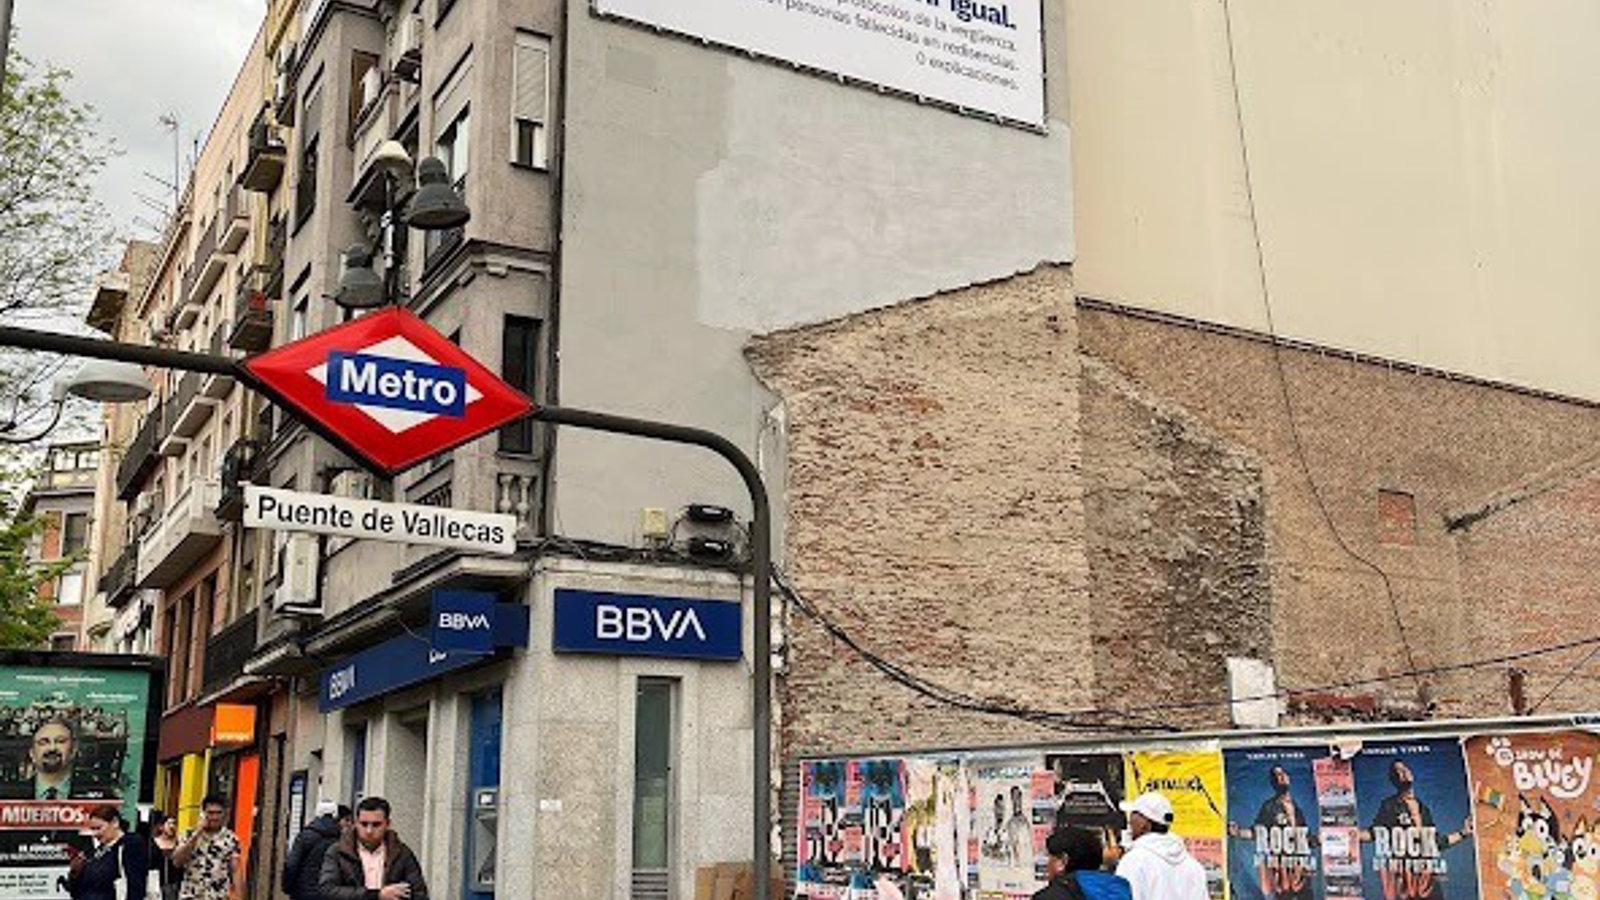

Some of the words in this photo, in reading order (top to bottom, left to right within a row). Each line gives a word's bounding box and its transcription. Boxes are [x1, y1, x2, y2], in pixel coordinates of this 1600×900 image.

[341, 359, 457, 406] Metro
[258, 495, 353, 527] Puente
[362, 508, 393, 533] de
[402, 511, 504, 544] Vallecas
[439, 612, 490, 630] BBVA
[597, 604, 706, 641] BBVA
[1513, 756, 1592, 798] BLUEY
[1255, 826, 1311, 855] ROCK
[1373, 826, 1440, 858] ROCK
